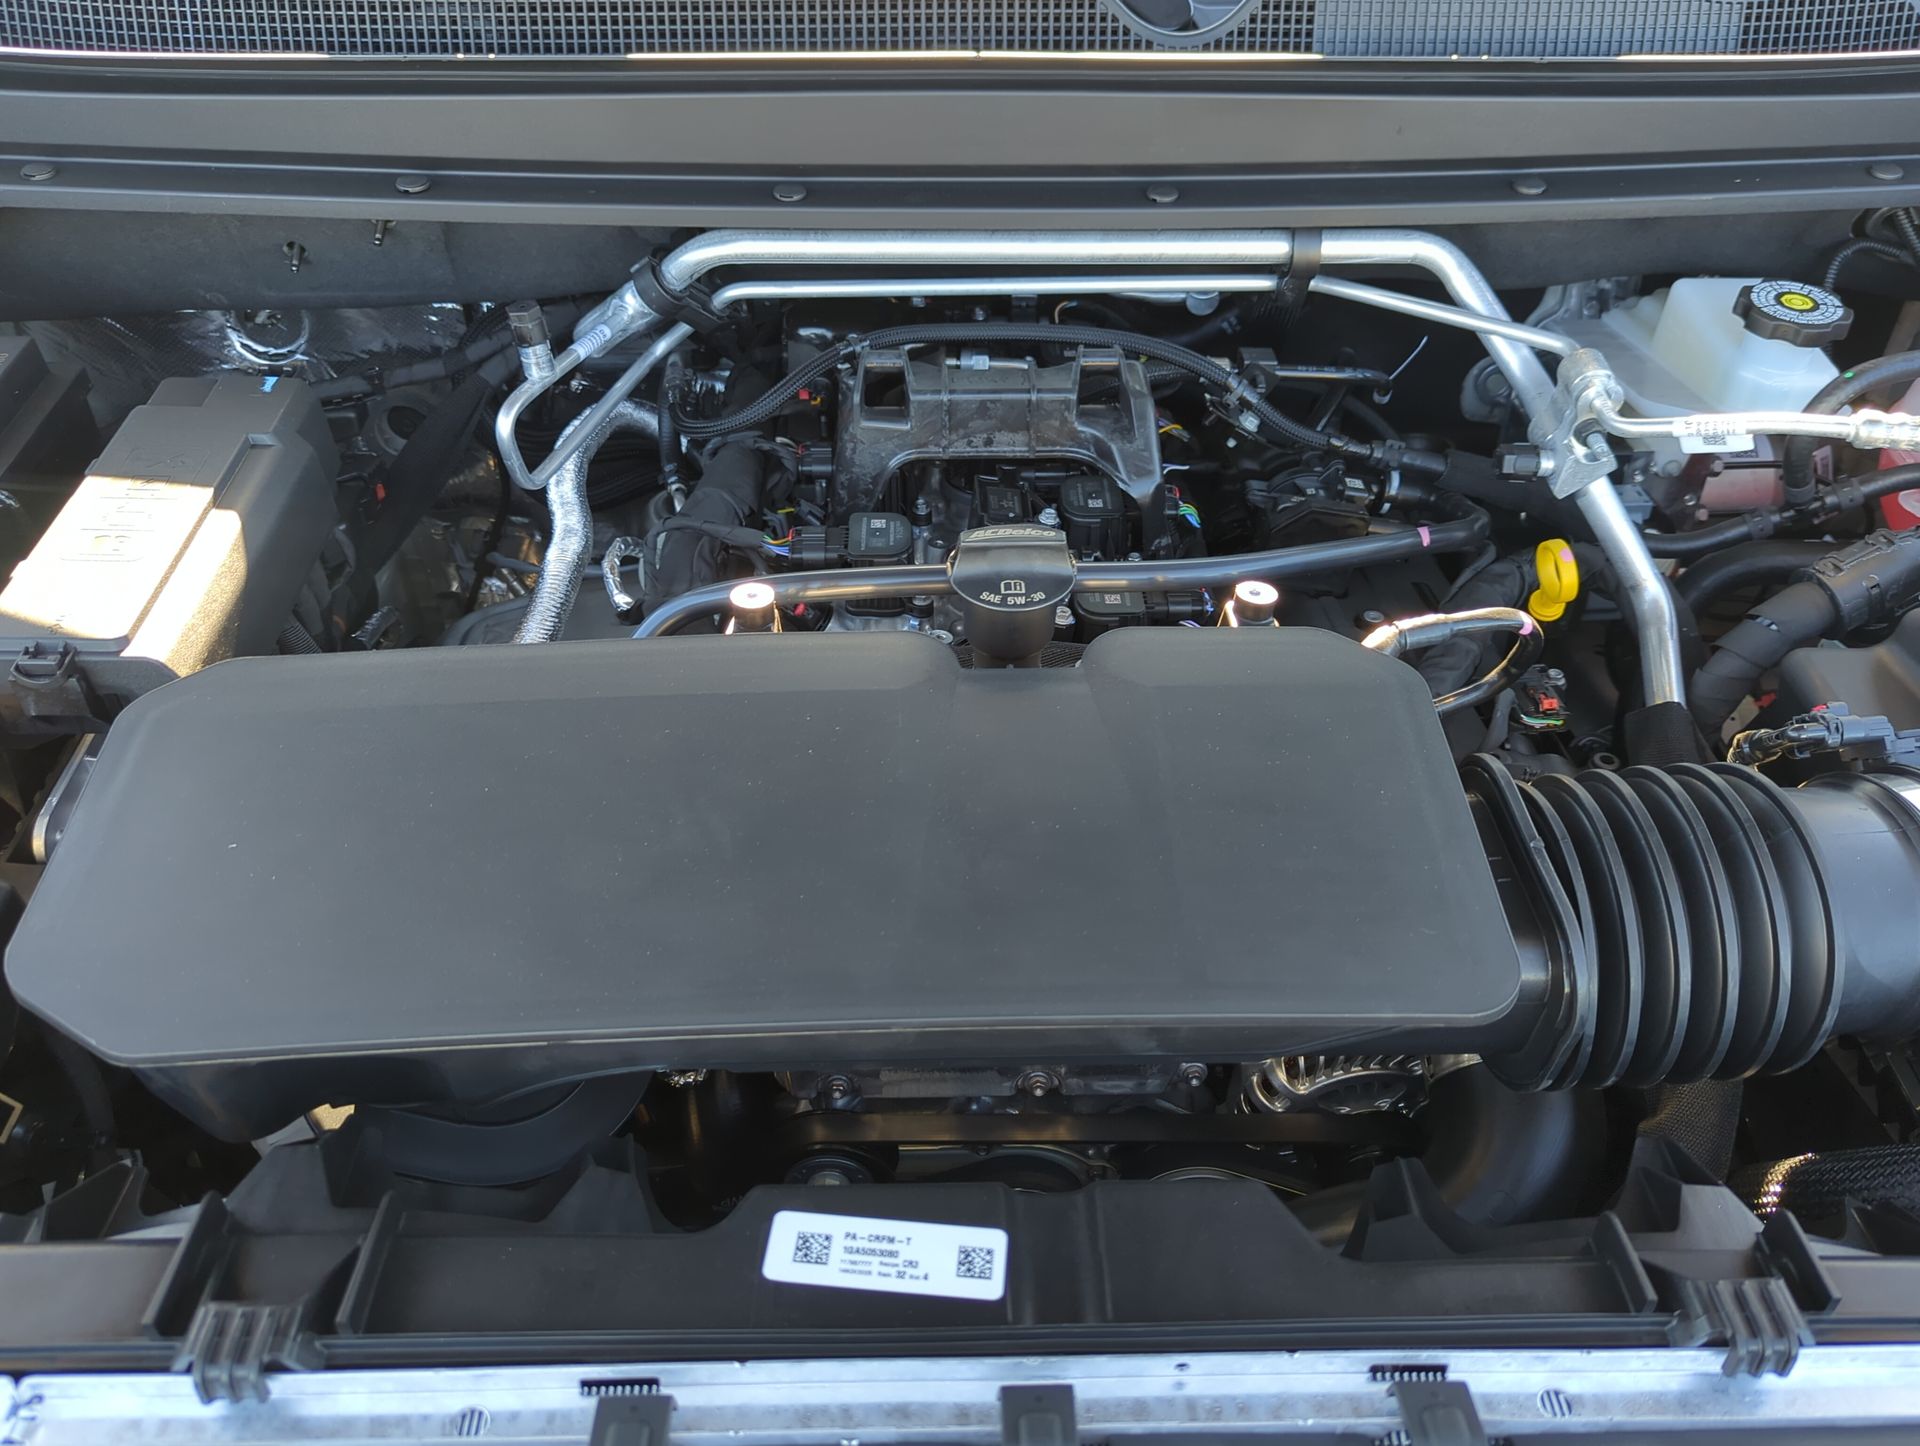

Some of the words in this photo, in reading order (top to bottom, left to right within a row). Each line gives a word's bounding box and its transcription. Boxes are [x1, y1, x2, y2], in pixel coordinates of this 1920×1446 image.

[968, 528, 1057, 539] ACDelco
[980, 591, 1003, 604] SAE
[1006, 591, 1046, 605] 5W-30
